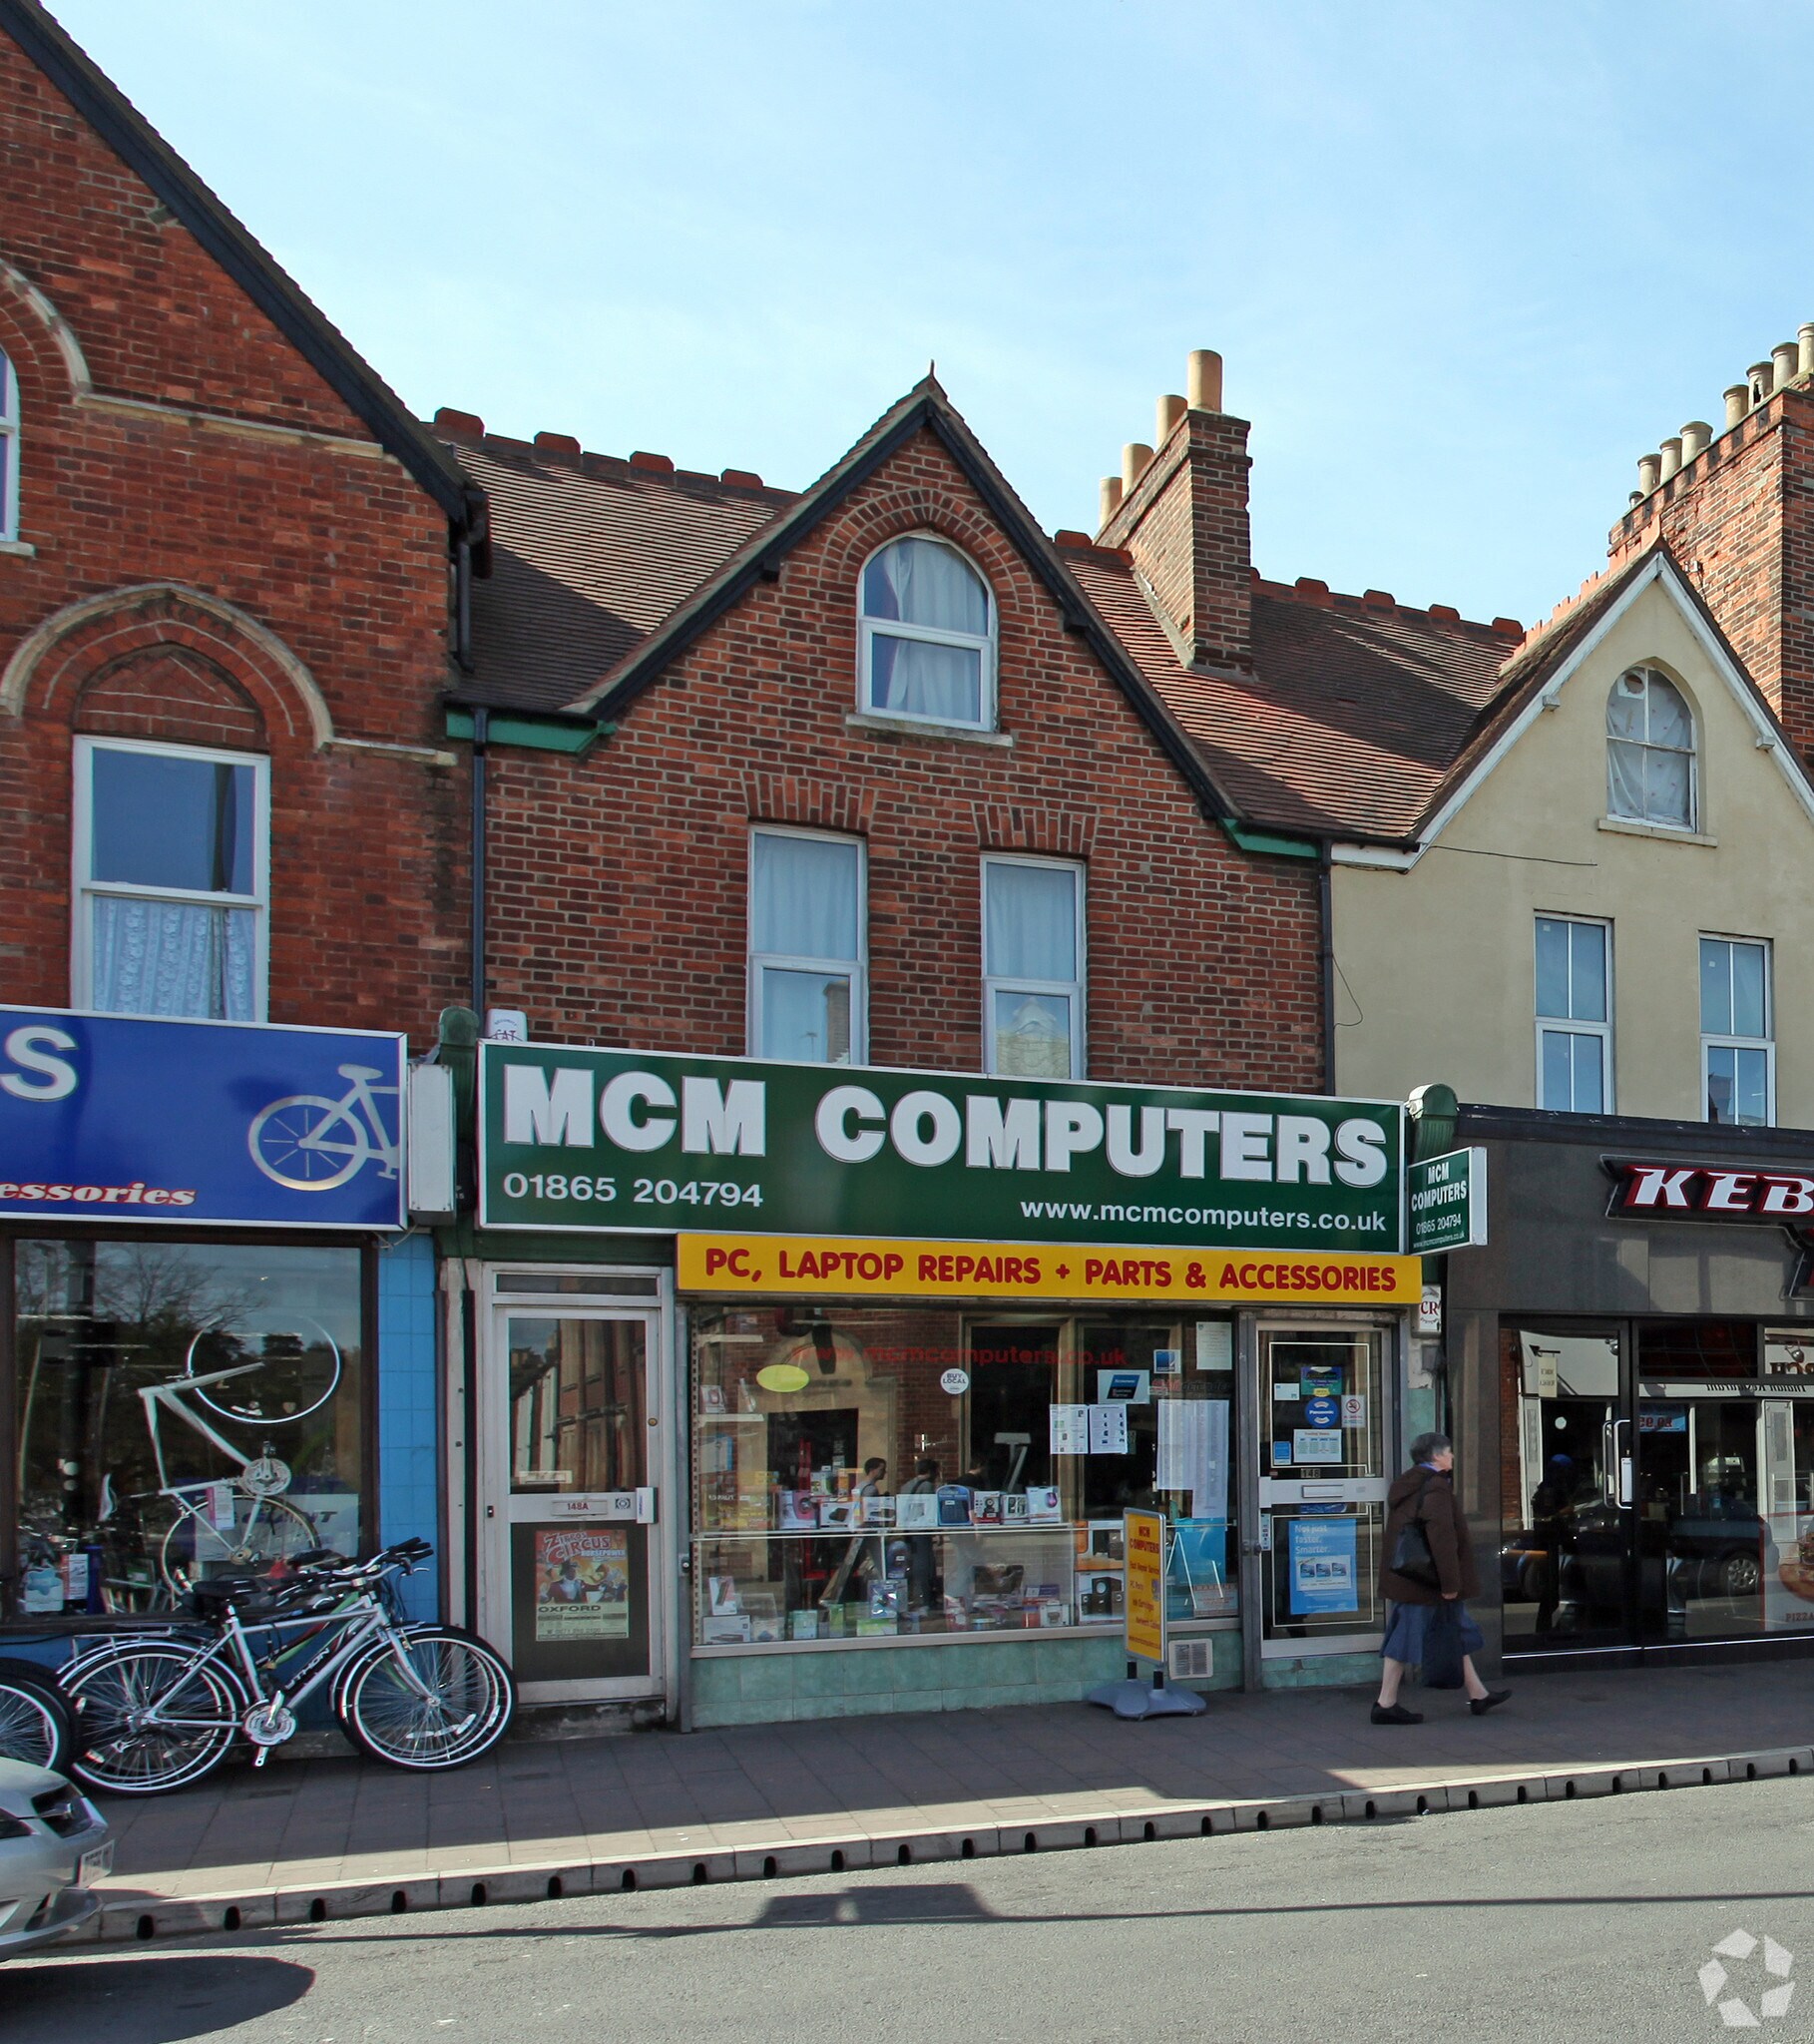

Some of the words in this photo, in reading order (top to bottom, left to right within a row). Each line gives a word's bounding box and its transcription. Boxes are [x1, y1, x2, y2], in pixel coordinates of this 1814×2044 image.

[504, 1064, 765, 1157] MCM
[814, 1085, 1387, 1188] COMPUTERS
[1428, 1162, 1449, 1185] MCM
[504, 1173, 617, 1202] 01865
[633, 1178, 763, 1207] 204794
[1411, 1180, 1467, 1212] COMPUTERS
[1021, 1201, 1387, 1232] www.mcmcomputers.co.uk
[1416, 1219, 1436, 1236] 01865
[1437, 1214, 1462, 1231] 204794
[1413, 1231, 1465, 1249] www.mcmcomputers.co.uk
[705, 1248, 761, 1282] PC,
[778, 1251, 904, 1280] LAPTOP
[918, 1255, 1042, 1284] REPAIRS
[1085, 1259, 1171, 1287] PARTS
[1185, 1262, 1206, 1288] &
[1219, 1263, 1397, 1291] ACCESSORIES
[1302, 1468, 1321, 1478] 148
[567, 1502, 589, 1511] 148A
[1294, 1524, 1310, 1533] Not
[548, 1536, 612, 1565] CIRCUS
